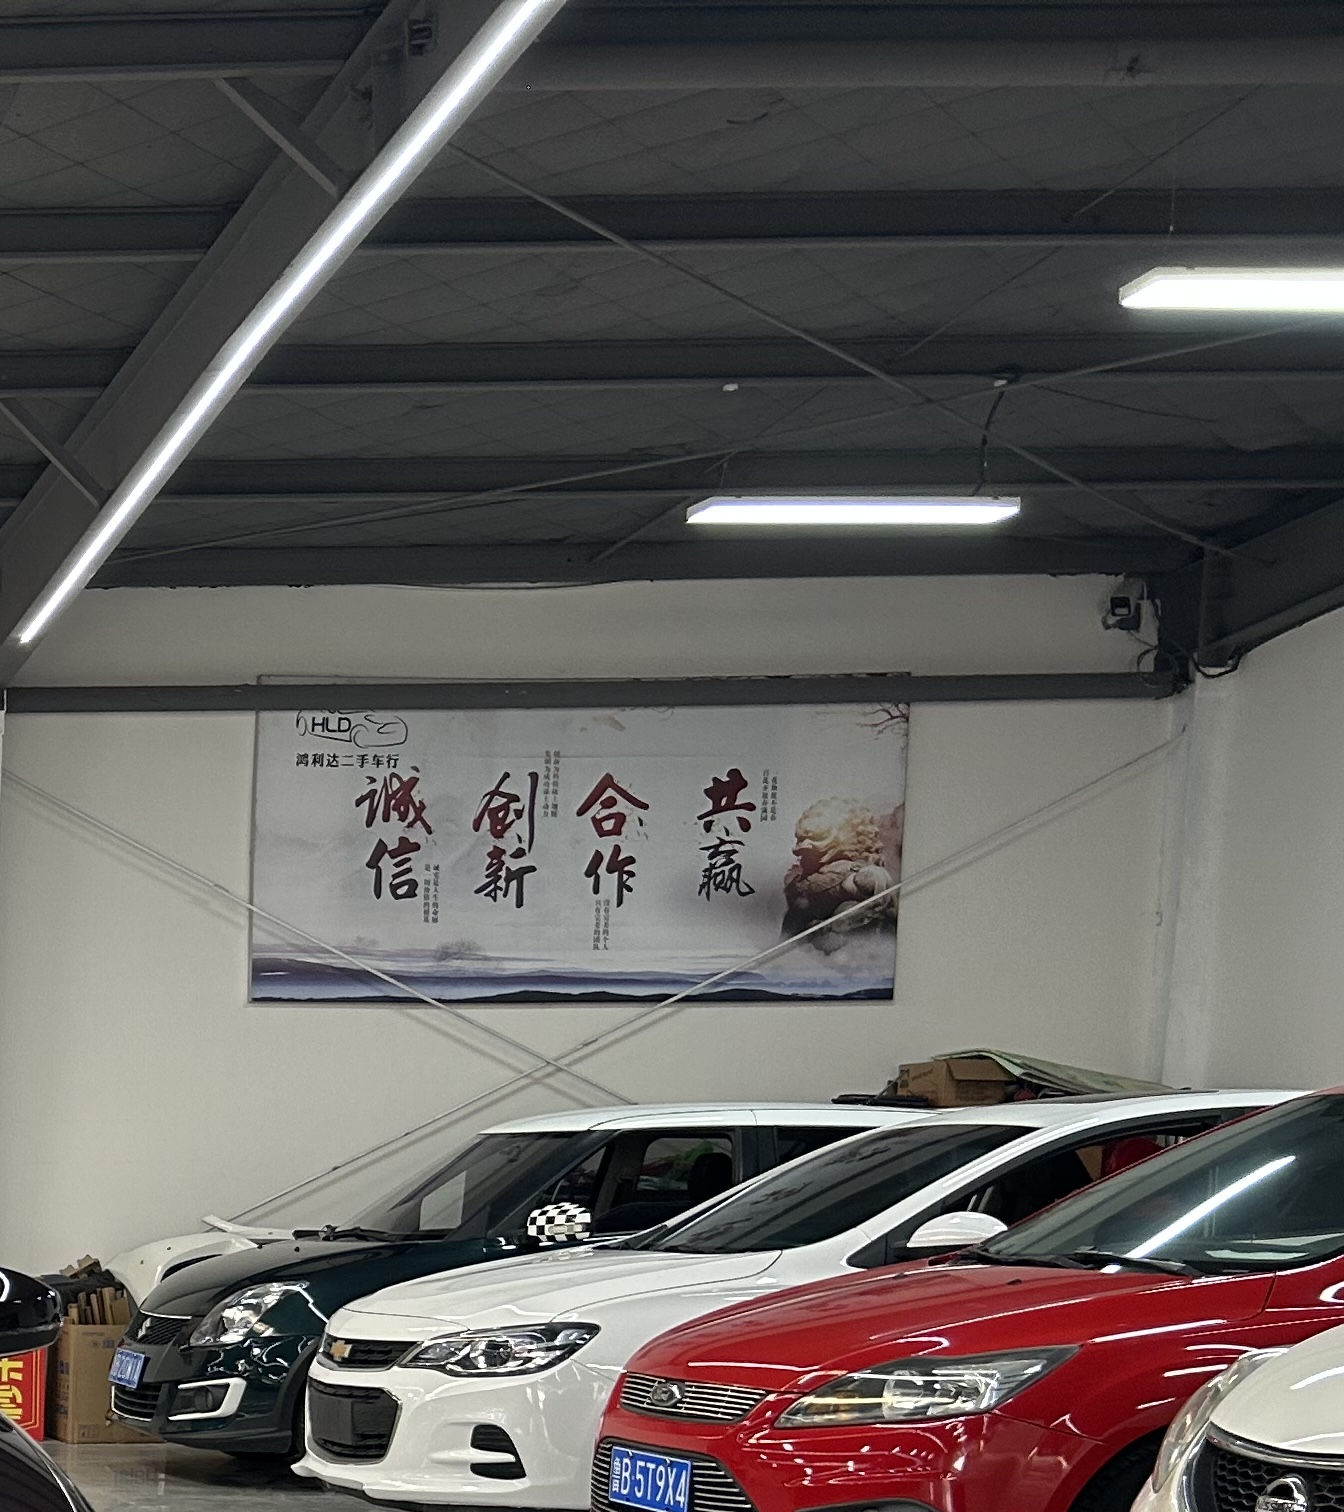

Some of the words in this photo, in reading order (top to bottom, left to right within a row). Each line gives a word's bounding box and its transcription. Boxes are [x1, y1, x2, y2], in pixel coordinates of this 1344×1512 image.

[295, 753, 400, 769] 鸿利达二手车行
[311, 716, 352, 733] HLD
[472, 771, 539, 908] 创新
[576, 772, 650, 908] 合作
[696, 768, 756, 902] 共赢
